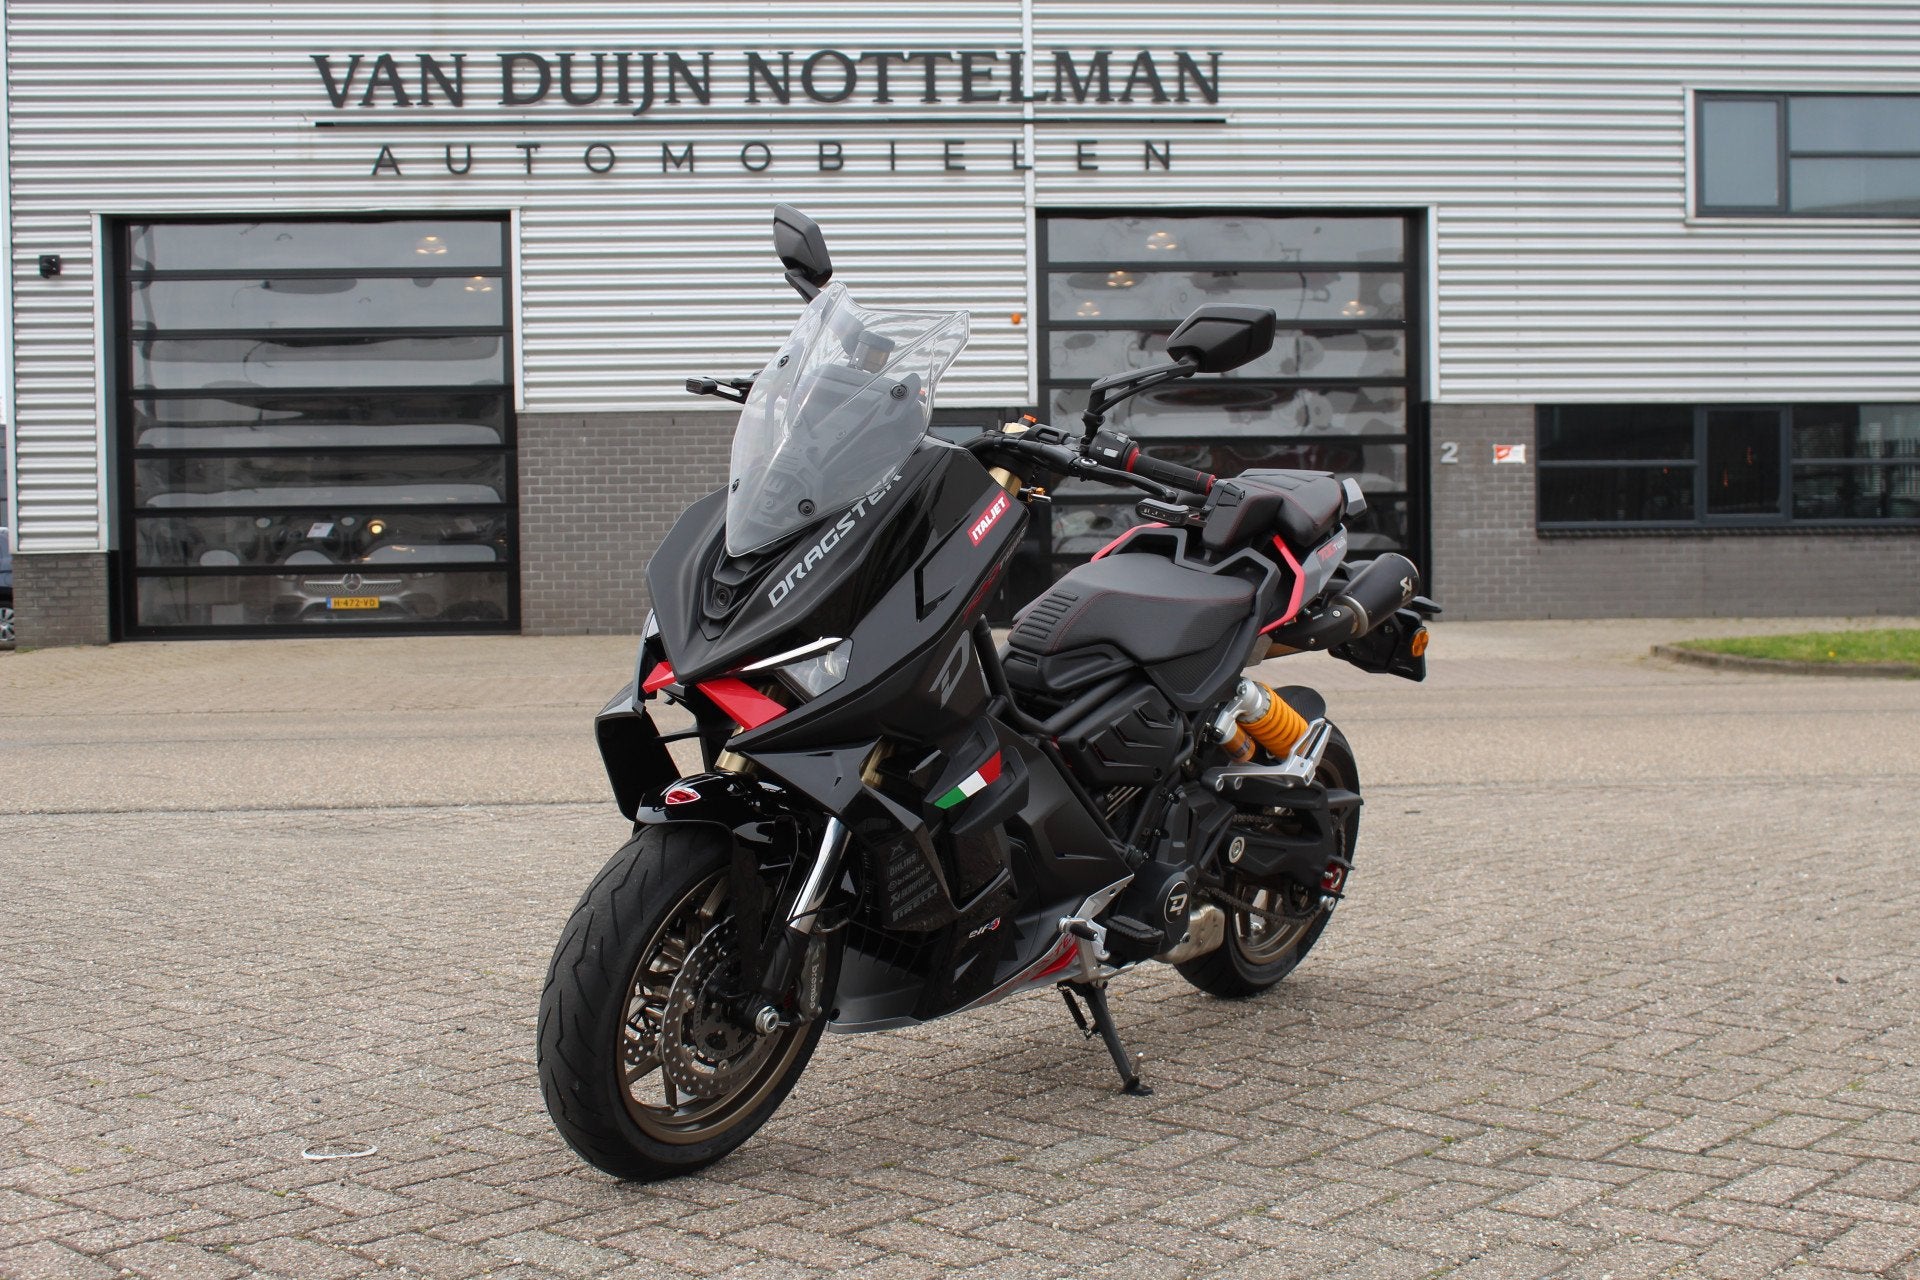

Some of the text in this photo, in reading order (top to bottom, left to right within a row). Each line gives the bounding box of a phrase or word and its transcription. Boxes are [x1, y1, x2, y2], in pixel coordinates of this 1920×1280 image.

[309, 49, 1223, 116] VAN DUIJN NOTTELMAN
[371, 139, 1171, 176] AUTOMOBIELEN
[1440, 441, 1459, 464] 2
[767, 465, 902, 608] DRAGSTER
[971, 496, 1006, 541] ITALJET
[809, 963, 820, 1009] brembo
